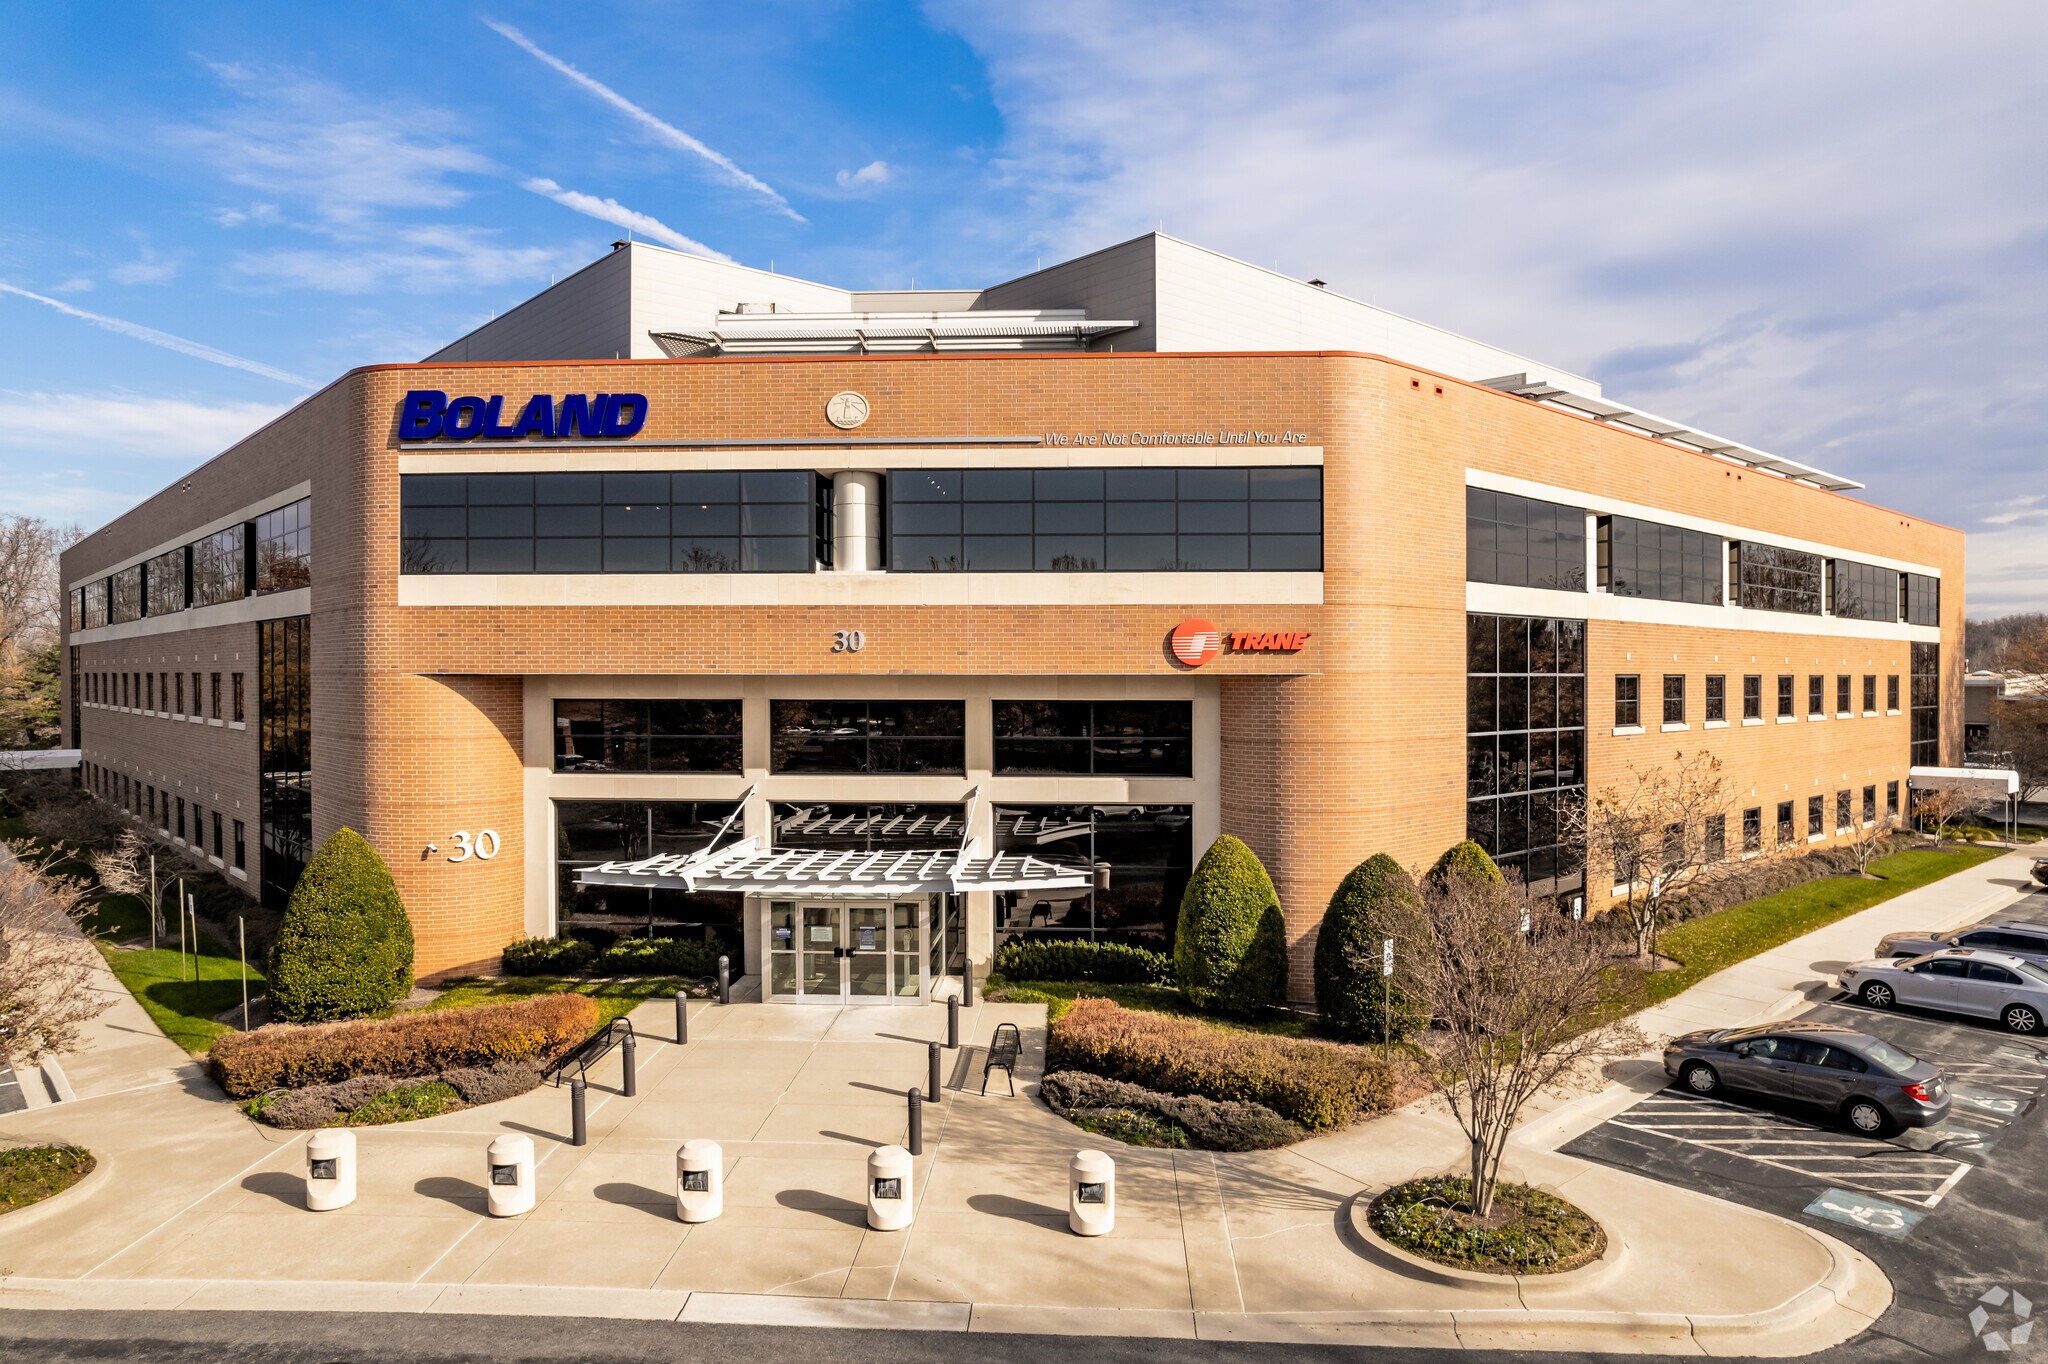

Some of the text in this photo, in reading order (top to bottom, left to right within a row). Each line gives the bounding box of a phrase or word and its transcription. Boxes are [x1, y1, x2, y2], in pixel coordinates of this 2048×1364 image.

[398, 390, 648, 439] BOLAND
[1044, 430, 1307, 446] We Are Not Comfortable Until You Are
[832, 629, 865, 652] 30
[1230, 631, 1311, 650] TRANE
[446, 829, 501, 863] 30
